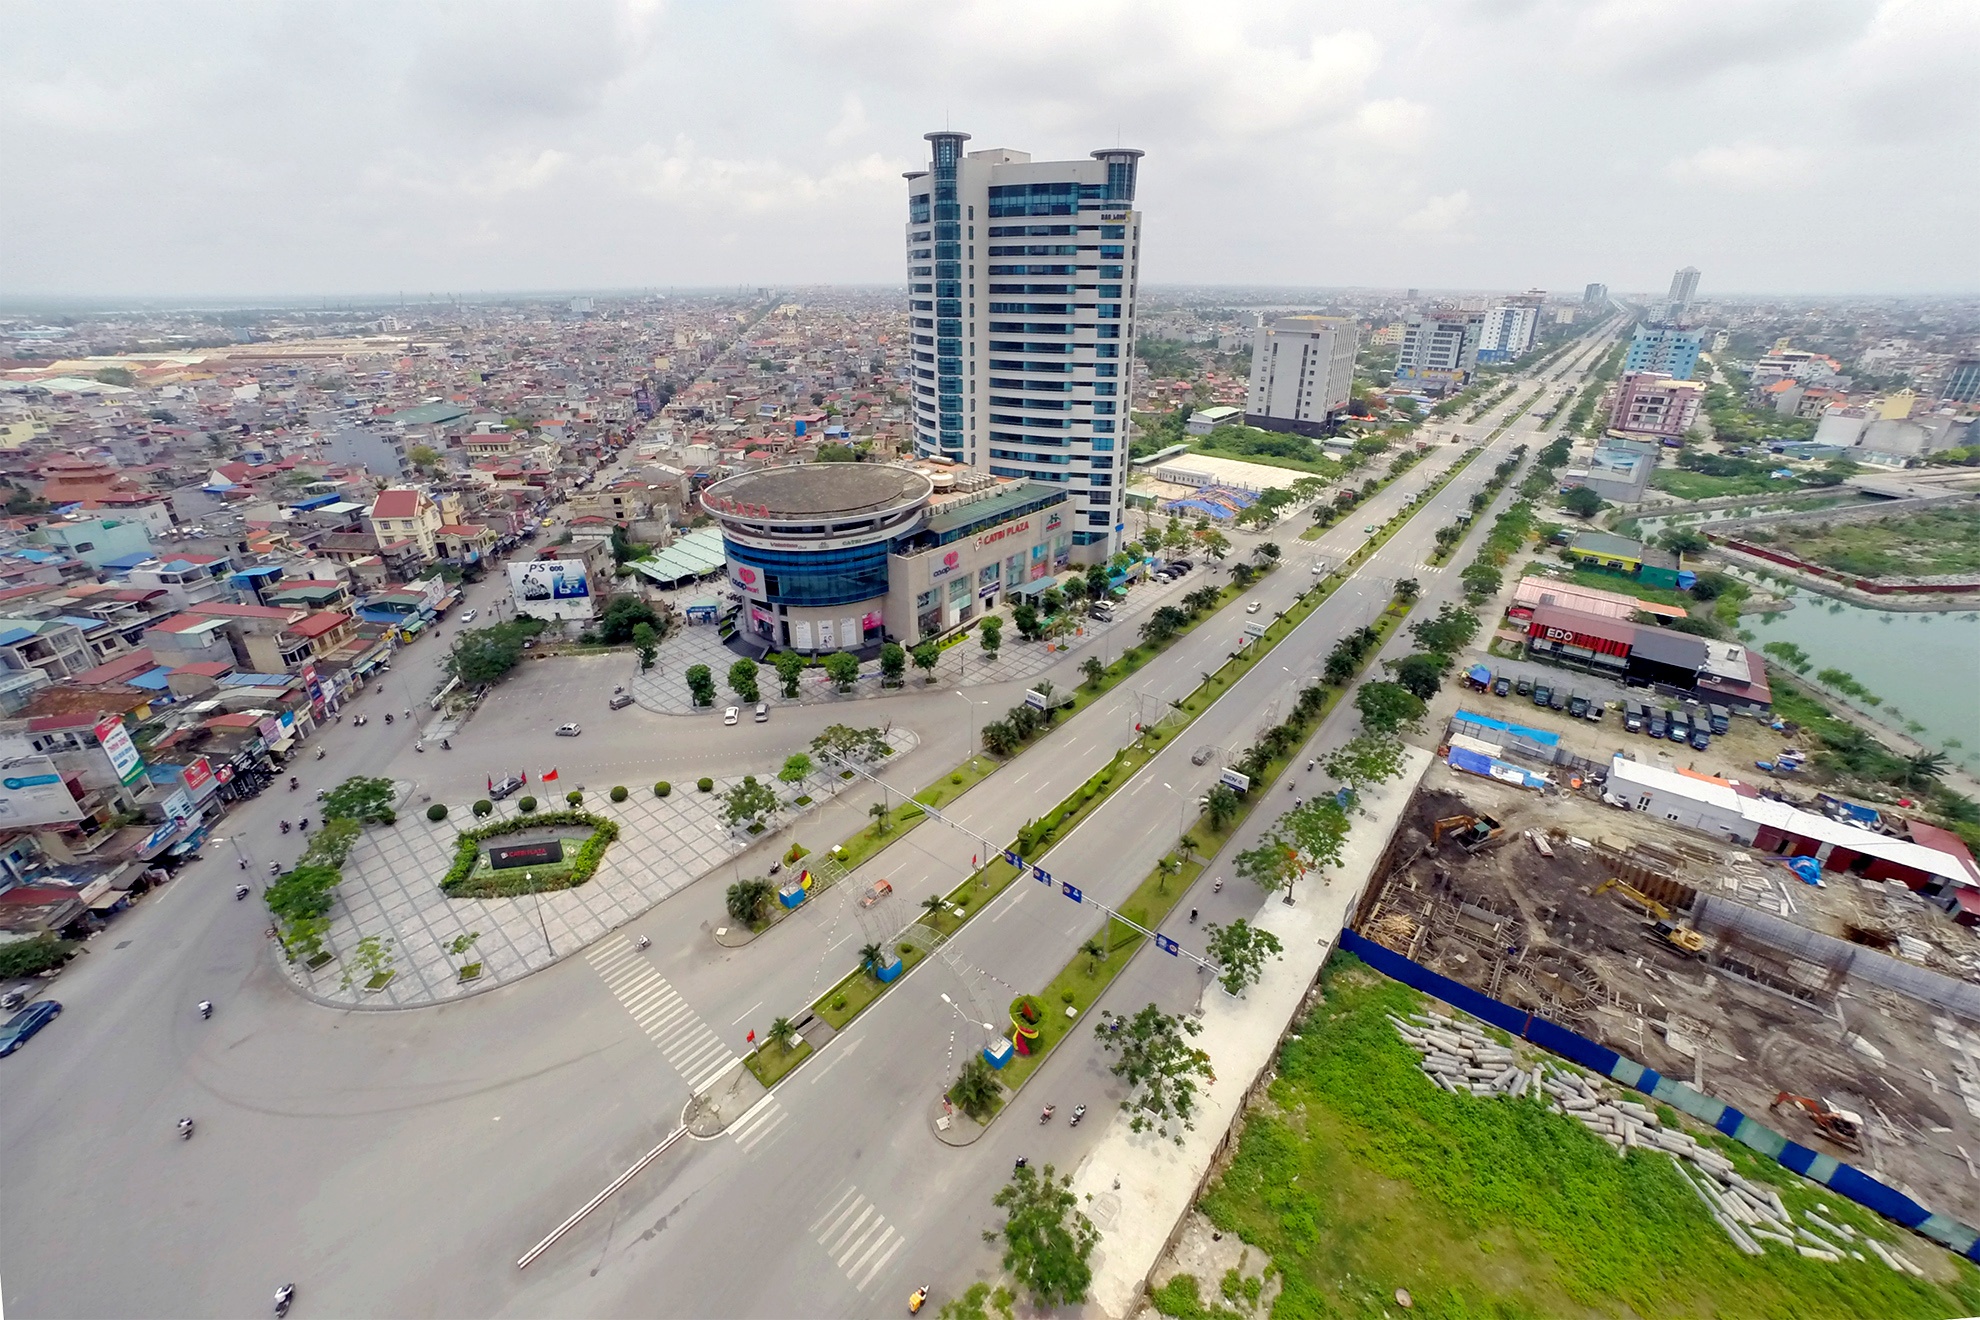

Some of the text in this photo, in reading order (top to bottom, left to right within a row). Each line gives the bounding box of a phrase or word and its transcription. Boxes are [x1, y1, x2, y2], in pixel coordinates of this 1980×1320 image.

[719, 497, 770, 520] PLAZA
[984, 529, 1005, 545] CATBI
[1006, 521, 1029, 537] PLAZA
[1547, 627, 1573, 641] EDO
